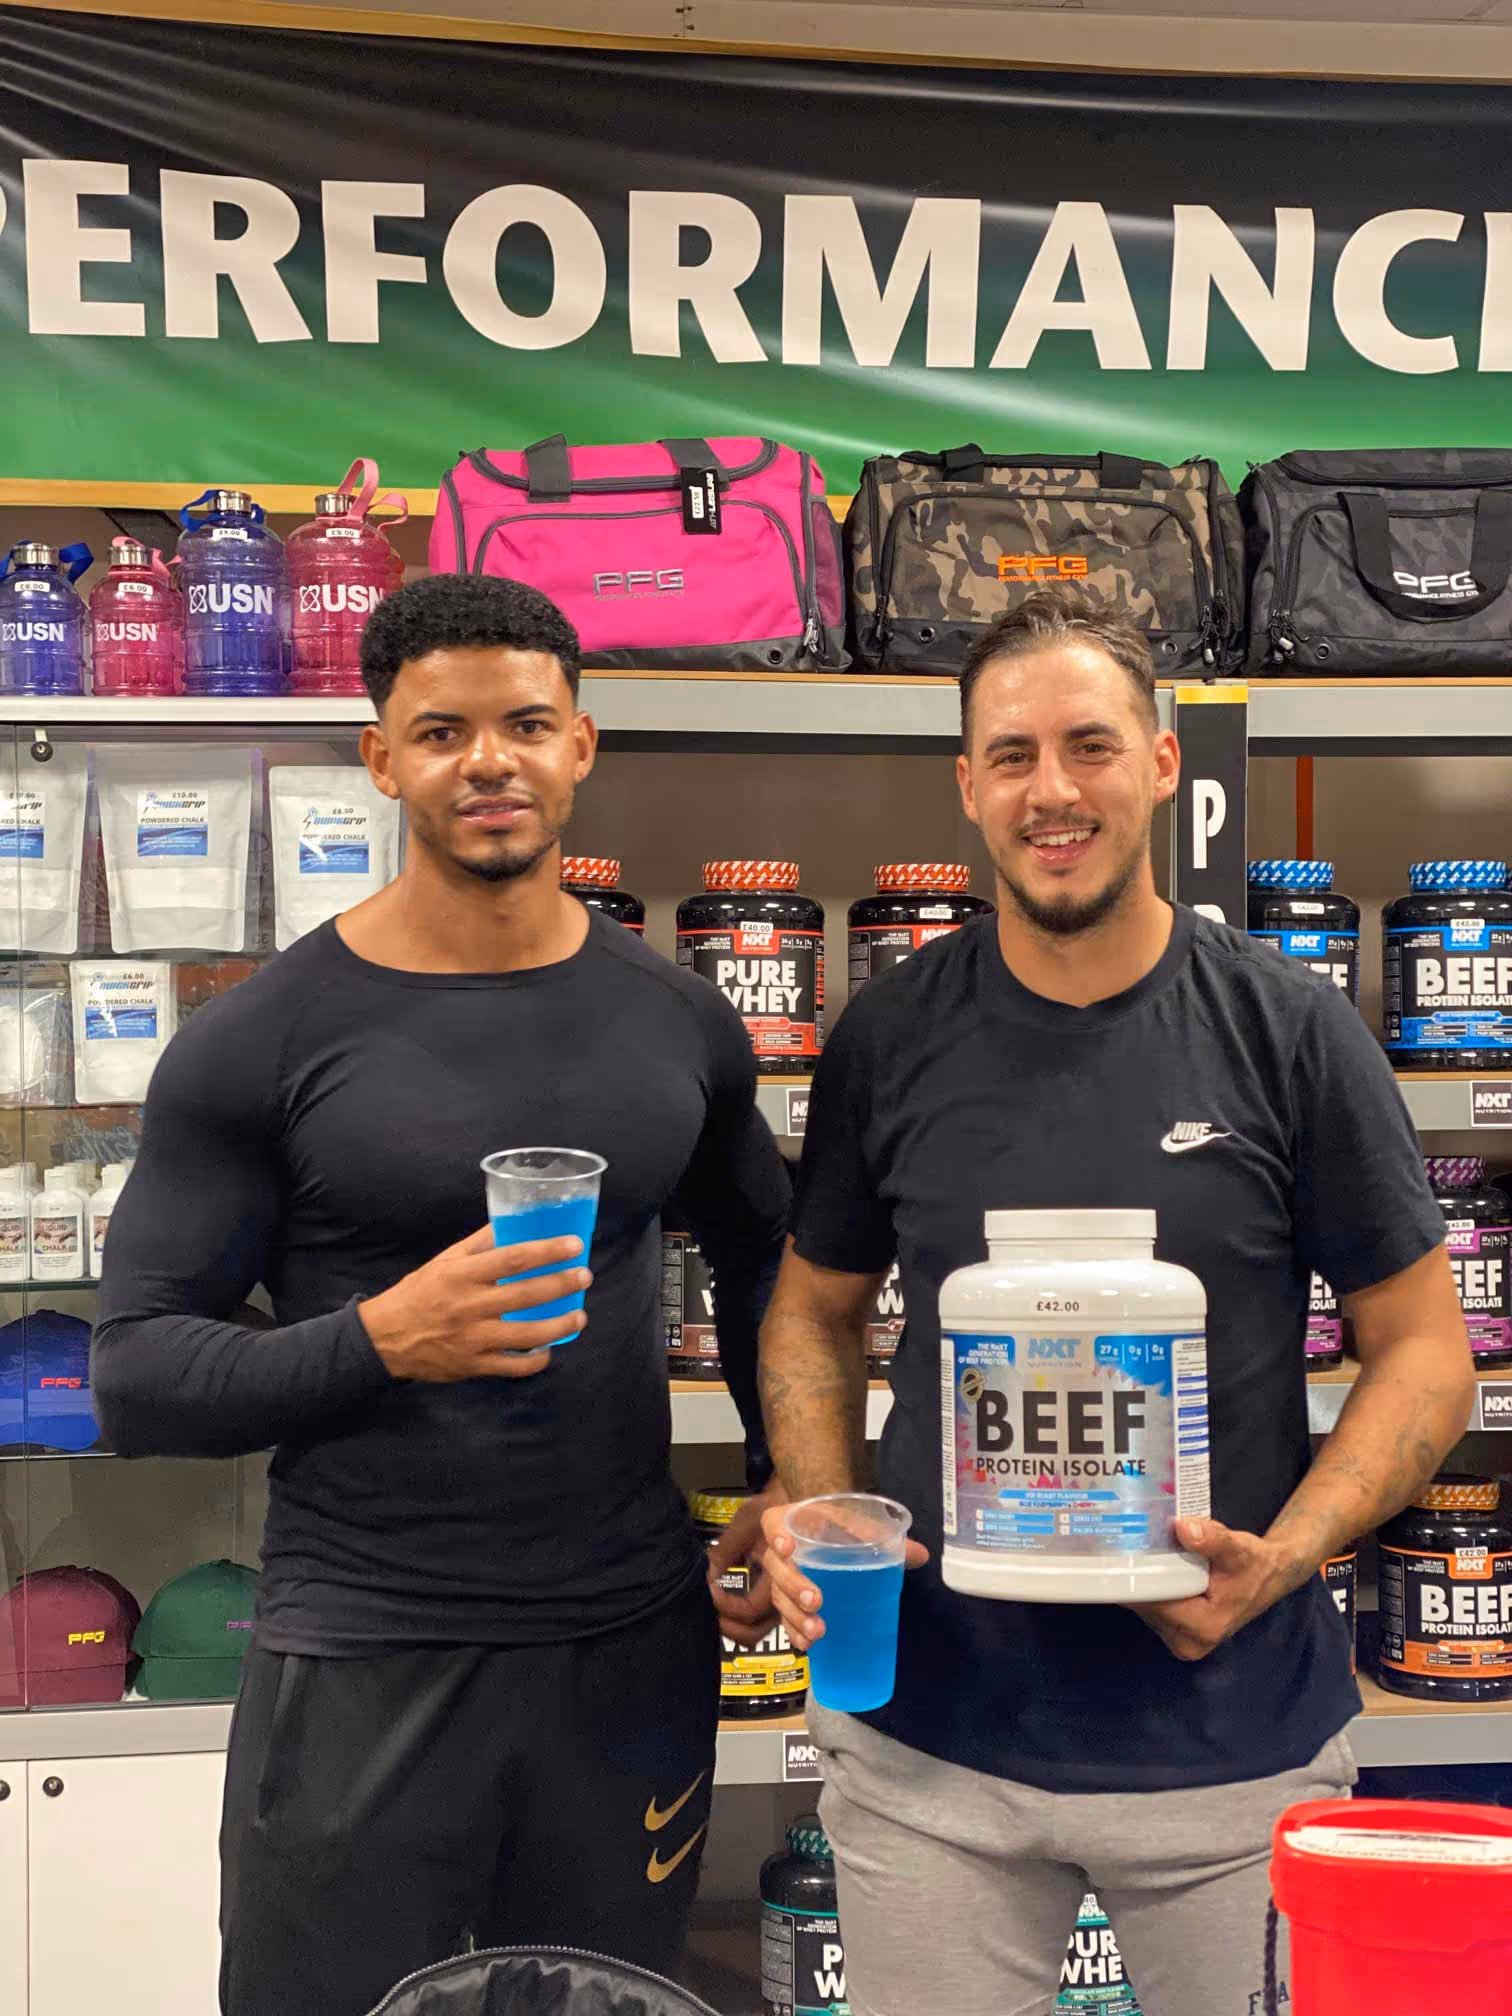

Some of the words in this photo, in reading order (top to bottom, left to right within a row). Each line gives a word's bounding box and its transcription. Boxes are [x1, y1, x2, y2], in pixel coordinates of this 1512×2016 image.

[0, 158, 1512, 374] ERFORMANC
[998, 556, 1088, 576] PFG
[593, 569, 684, 592] PFG
[209, 584, 273, 614] USN
[17, 622, 64, 641] USN
[110, 622, 157, 641] USN
[717, 960, 796, 987] PURE
[1416, 995, 1469, 1007] PROTEIN
[1475, 1093, 1511, 1108] NXT
[1171, 1122, 1213, 1141] NIKE
[1036, 1301, 1080, 1312] £42.00
[1309, 1298, 1336, 1310] OLATE
[1463, 1297, 1502, 1309] ISOLATE
[1028, 1338, 1082, 1359] NXT
[1485, 1396, 1512, 1411] NX
[976, 1389, 1146, 1455] BEEF
[976, 1457, 1055, 1476] PROTEIN
[1064, 1459, 1147, 1477] ISOLATE
[68, 1630, 106, 1645] PFG
[1421, 1622, 1474, 1635] PROTEIN
[1067, 1929, 1120, 1958] UR
[1060, 1955, 1123, 1985] WHE
